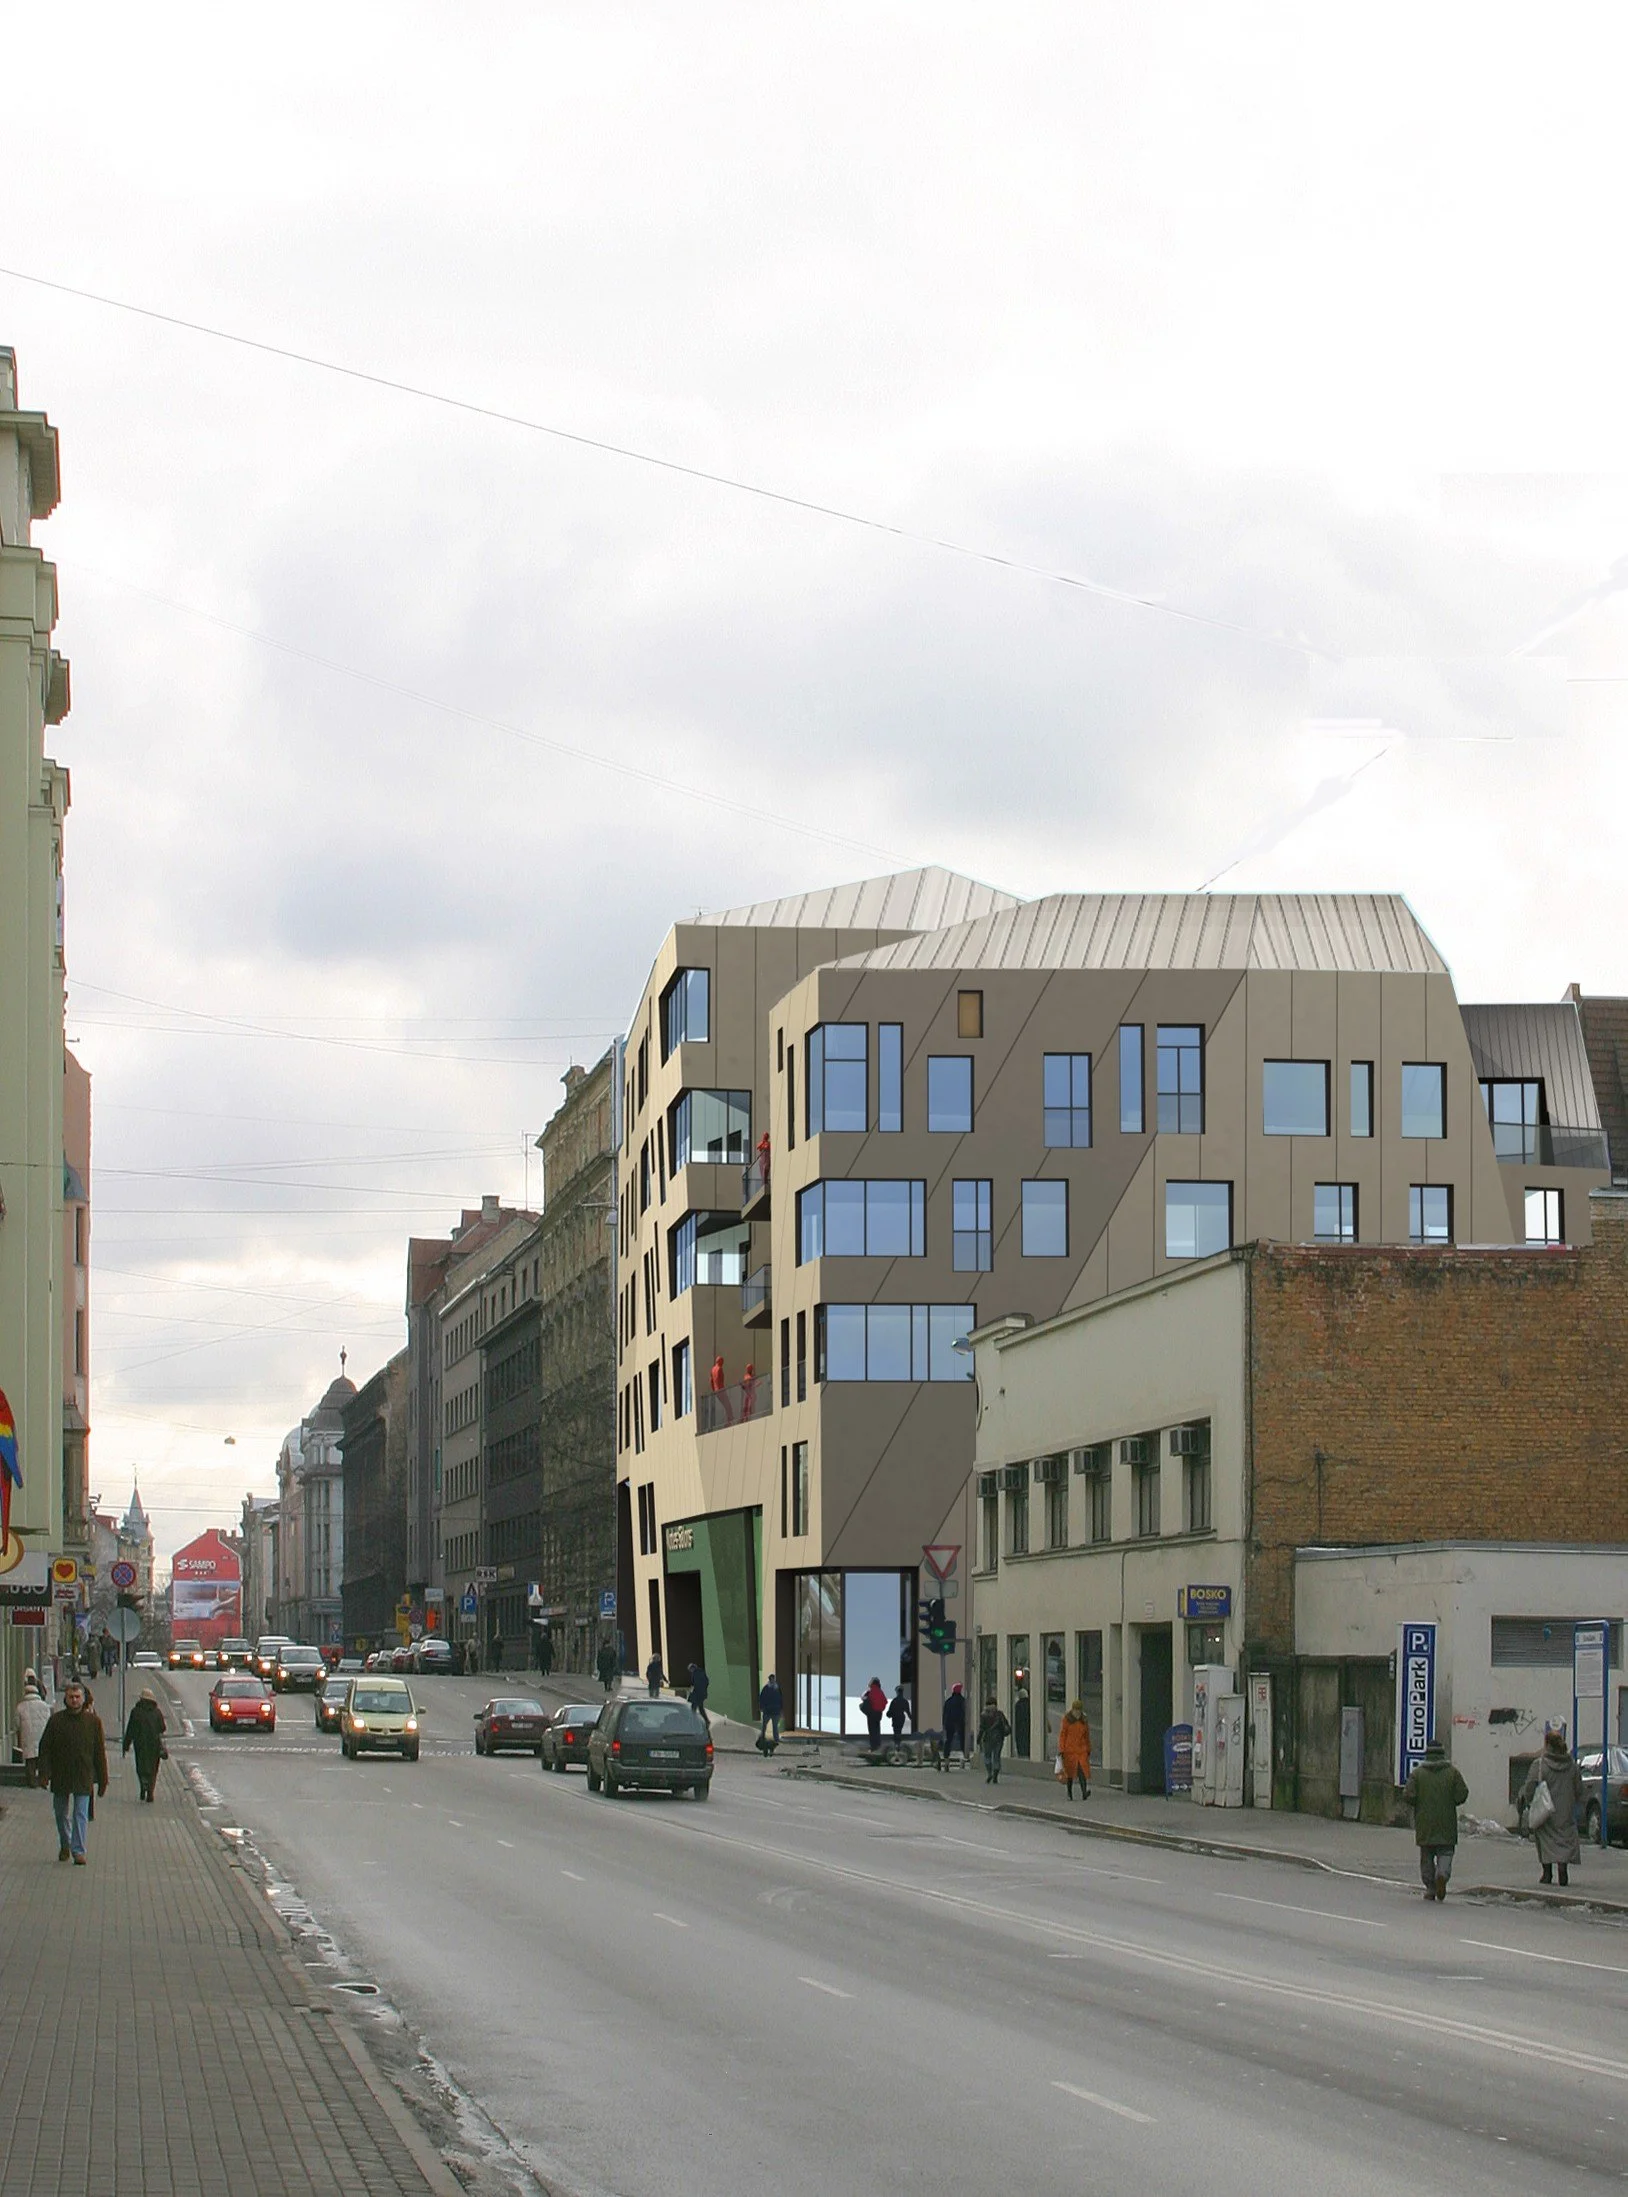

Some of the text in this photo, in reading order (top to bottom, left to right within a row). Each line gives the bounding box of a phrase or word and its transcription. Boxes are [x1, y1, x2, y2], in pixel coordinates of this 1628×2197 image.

[1190, 1588, 1226, 1600] BOSKO
[463, 1597, 473, 1611] P
[1409, 1660, 1427, 1750] EuroPark
